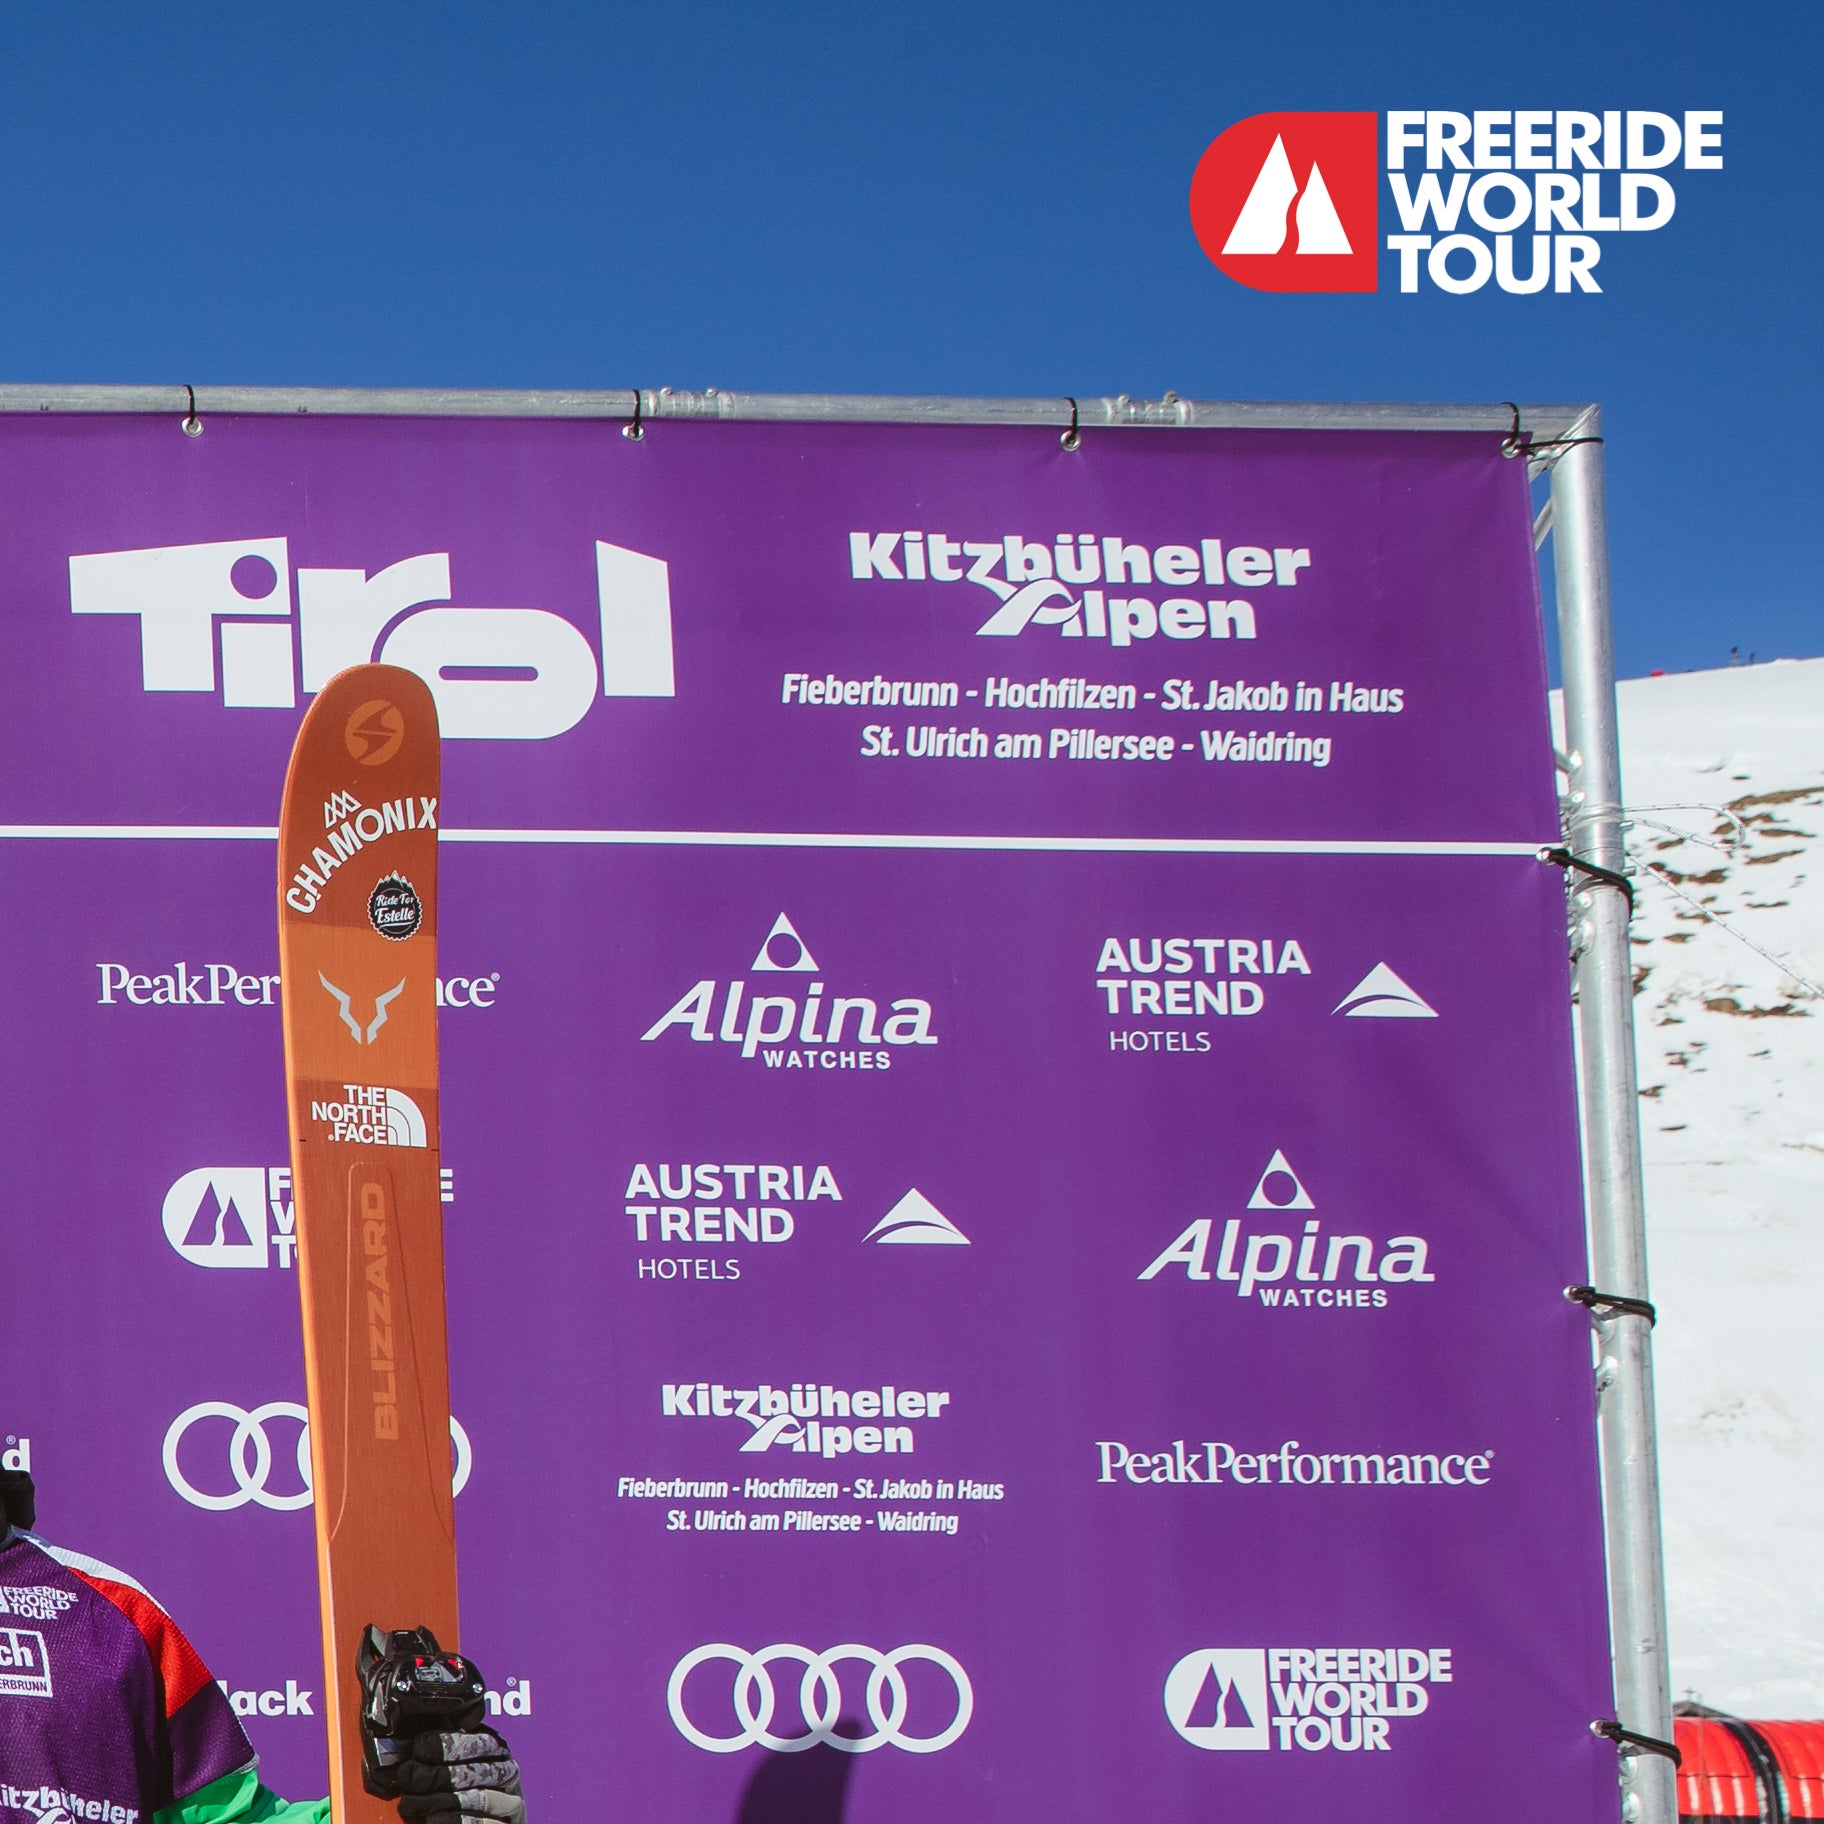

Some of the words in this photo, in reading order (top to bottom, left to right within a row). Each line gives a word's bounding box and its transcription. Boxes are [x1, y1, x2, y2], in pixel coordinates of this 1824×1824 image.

[849, 530, 1311, 601] Kitzbüheler
[974, 579, 1257, 647] Alpen
[69, 537, 675, 740] Tirol
[782, 674, 958, 706] Fieberbrunn
[985, 678, 1136, 709] Hochfilzen
[1161, 679, 1199, 710] St.
[1203, 680, 1288, 711] Jakob
[1295, 682, 1322, 711] in
[1330, 682, 1403, 712] Haus
[861, 725, 899, 756] St.
[906, 726, 988, 757] Ulrich
[994, 734, 1041, 758] am
[1049, 729, 1174, 760] Pillersee
[1201, 731, 1331, 767] Waidring
[285, 797, 438, 914] CHAMONIX
[1097, 938, 1311, 974] AUSTRIA
[1097, 980, 1263, 1015] TREND
[641, 981, 937, 1059] Alpina
[763, 1050, 890, 1069] WATCHES
[1110, 1031, 1210, 1052] HOTELS
[311, 1101, 387, 1125] NORTH
[343, 1084, 385, 1107] THE
[333, 1122, 388, 1145] FACE
[625, 1164, 842, 1200] AUSTRIA
[626, 1206, 793, 1242] TREND
[639, 1259, 740, 1279] HOTELS
[1138, 1219, 1434, 1296] Alpina
[361, 1181, 399, 1441] BLIZZARD
[1259, 1289, 1387, 1307] WATCHES
[662, 1384, 951, 1428] Kitzbüheler
[738, 1414, 914, 1458] Alpen
[618, 1478, 728, 1501] Fieberbrunn
[744, 1478, 838, 1502] Hochfilzen
[853, 1479, 877, 1499] St.
[879, 1479, 932, 1499] Jakob
[936, 1479, 953, 1499] in
[958, 1480, 1004, 1500] Haus
[667, 1510, 690, 1530] St.
[695, 1510, 746, 1533] Ulrich
[749, 1515, 779, 1533] am
[783, 1511, 861, 1531] Pillersee
[877, 1511, 958, 1537] Waidring
[1269, 1649, 1452, 1684] FREERIDE
[1271, 1682, 1428, 1718] WORLD
[1272, 1716, 1390, 1751] TOUR
